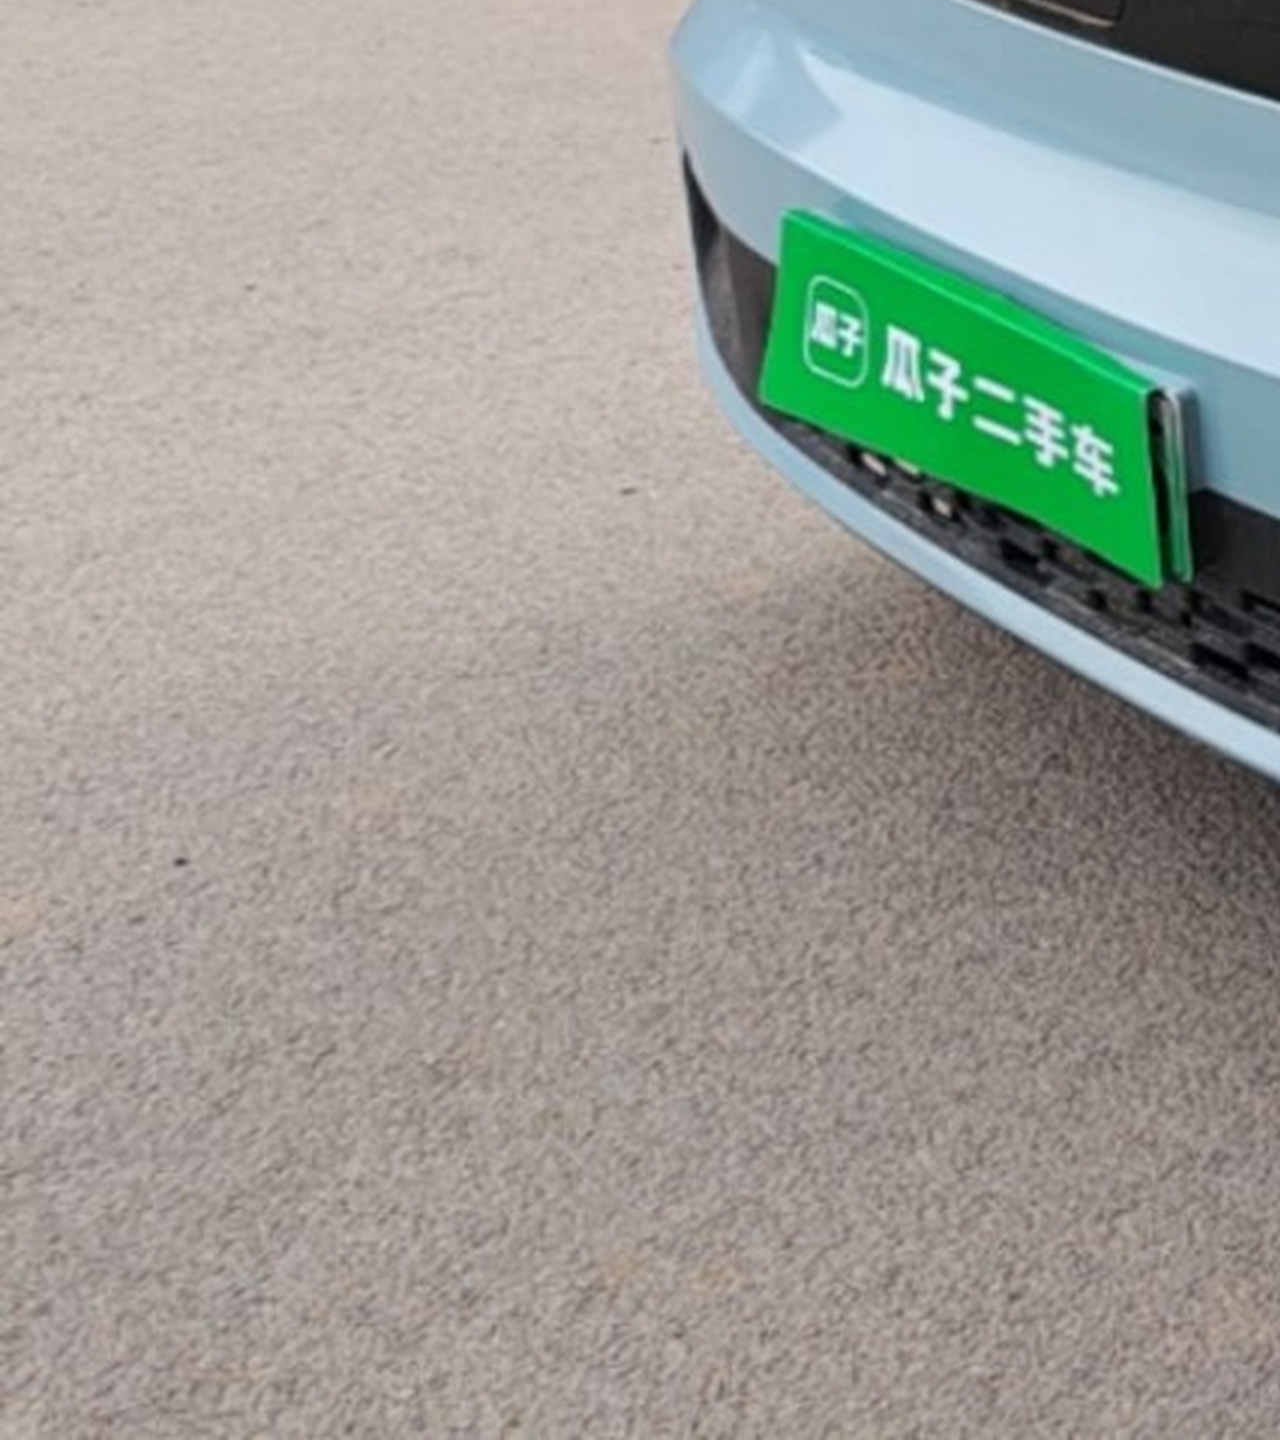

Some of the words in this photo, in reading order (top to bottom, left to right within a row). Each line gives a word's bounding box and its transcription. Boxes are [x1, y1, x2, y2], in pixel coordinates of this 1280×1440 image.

[880, 323, 1120, 498] 瓜子二手车
